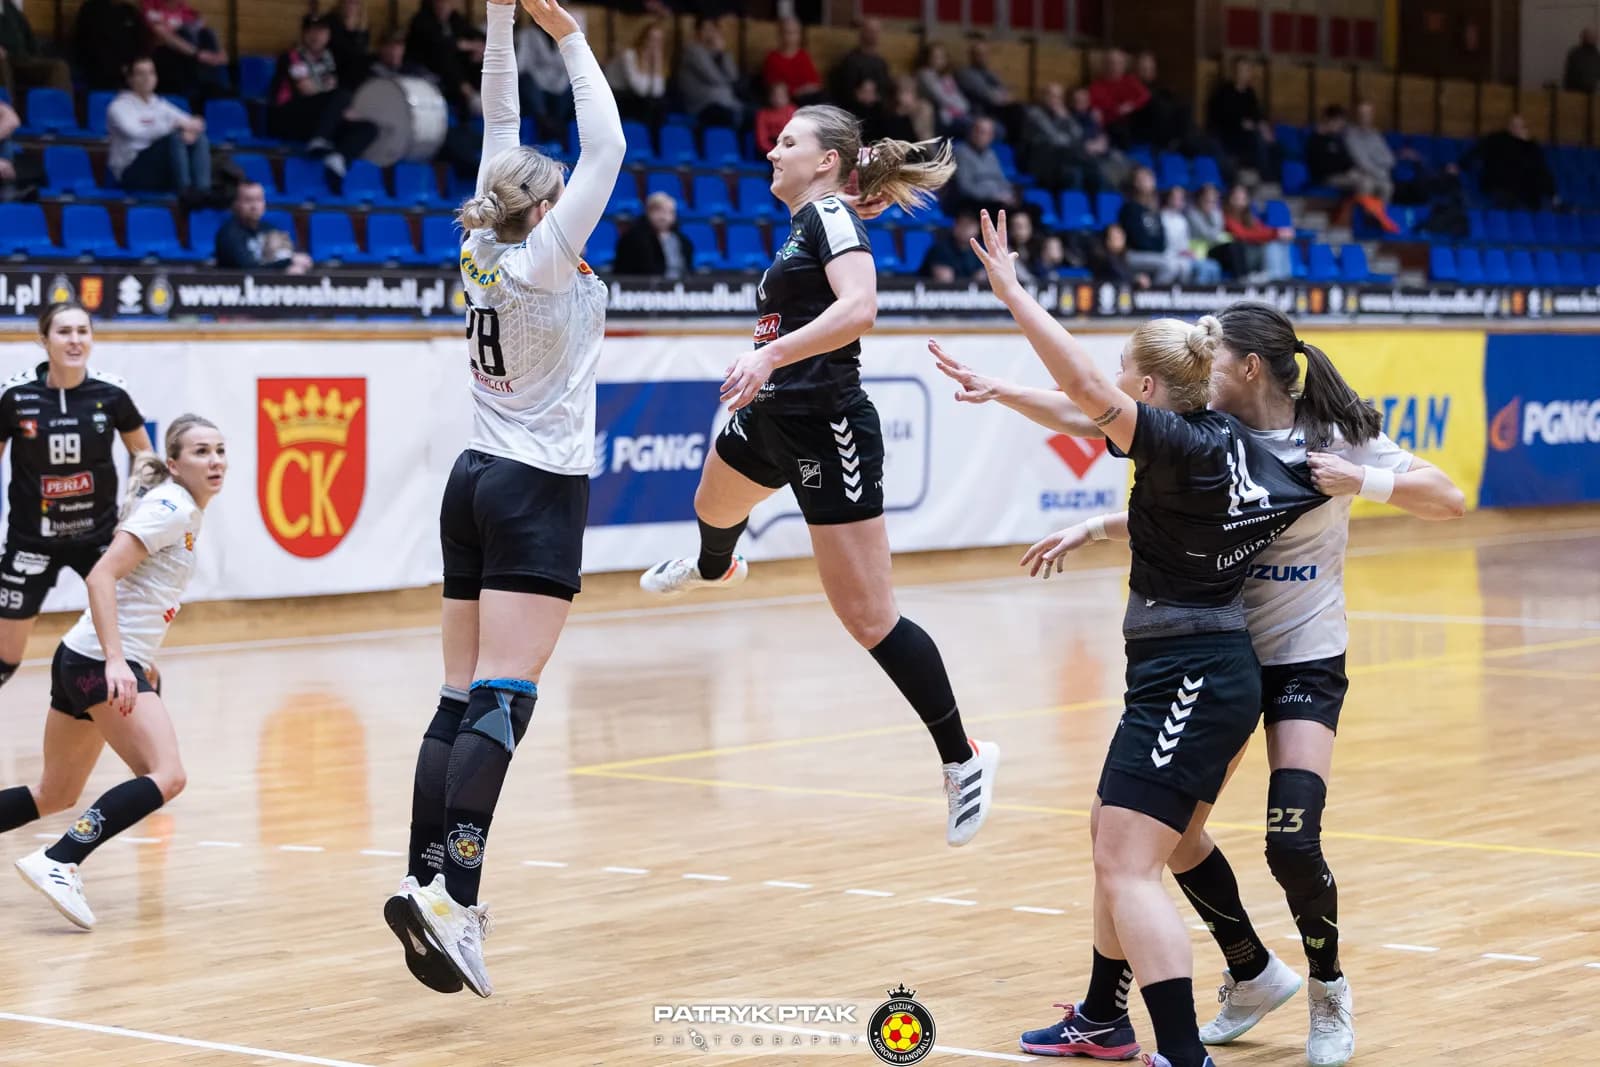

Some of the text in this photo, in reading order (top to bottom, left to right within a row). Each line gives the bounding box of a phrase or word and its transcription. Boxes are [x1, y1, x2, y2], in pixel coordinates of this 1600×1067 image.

[1369, 396, 1451, 450] TAN
[49, 433, 81, 464] 89
[266, 447, 347, 539] CK
[1267, 808, 1306, 833] 23
